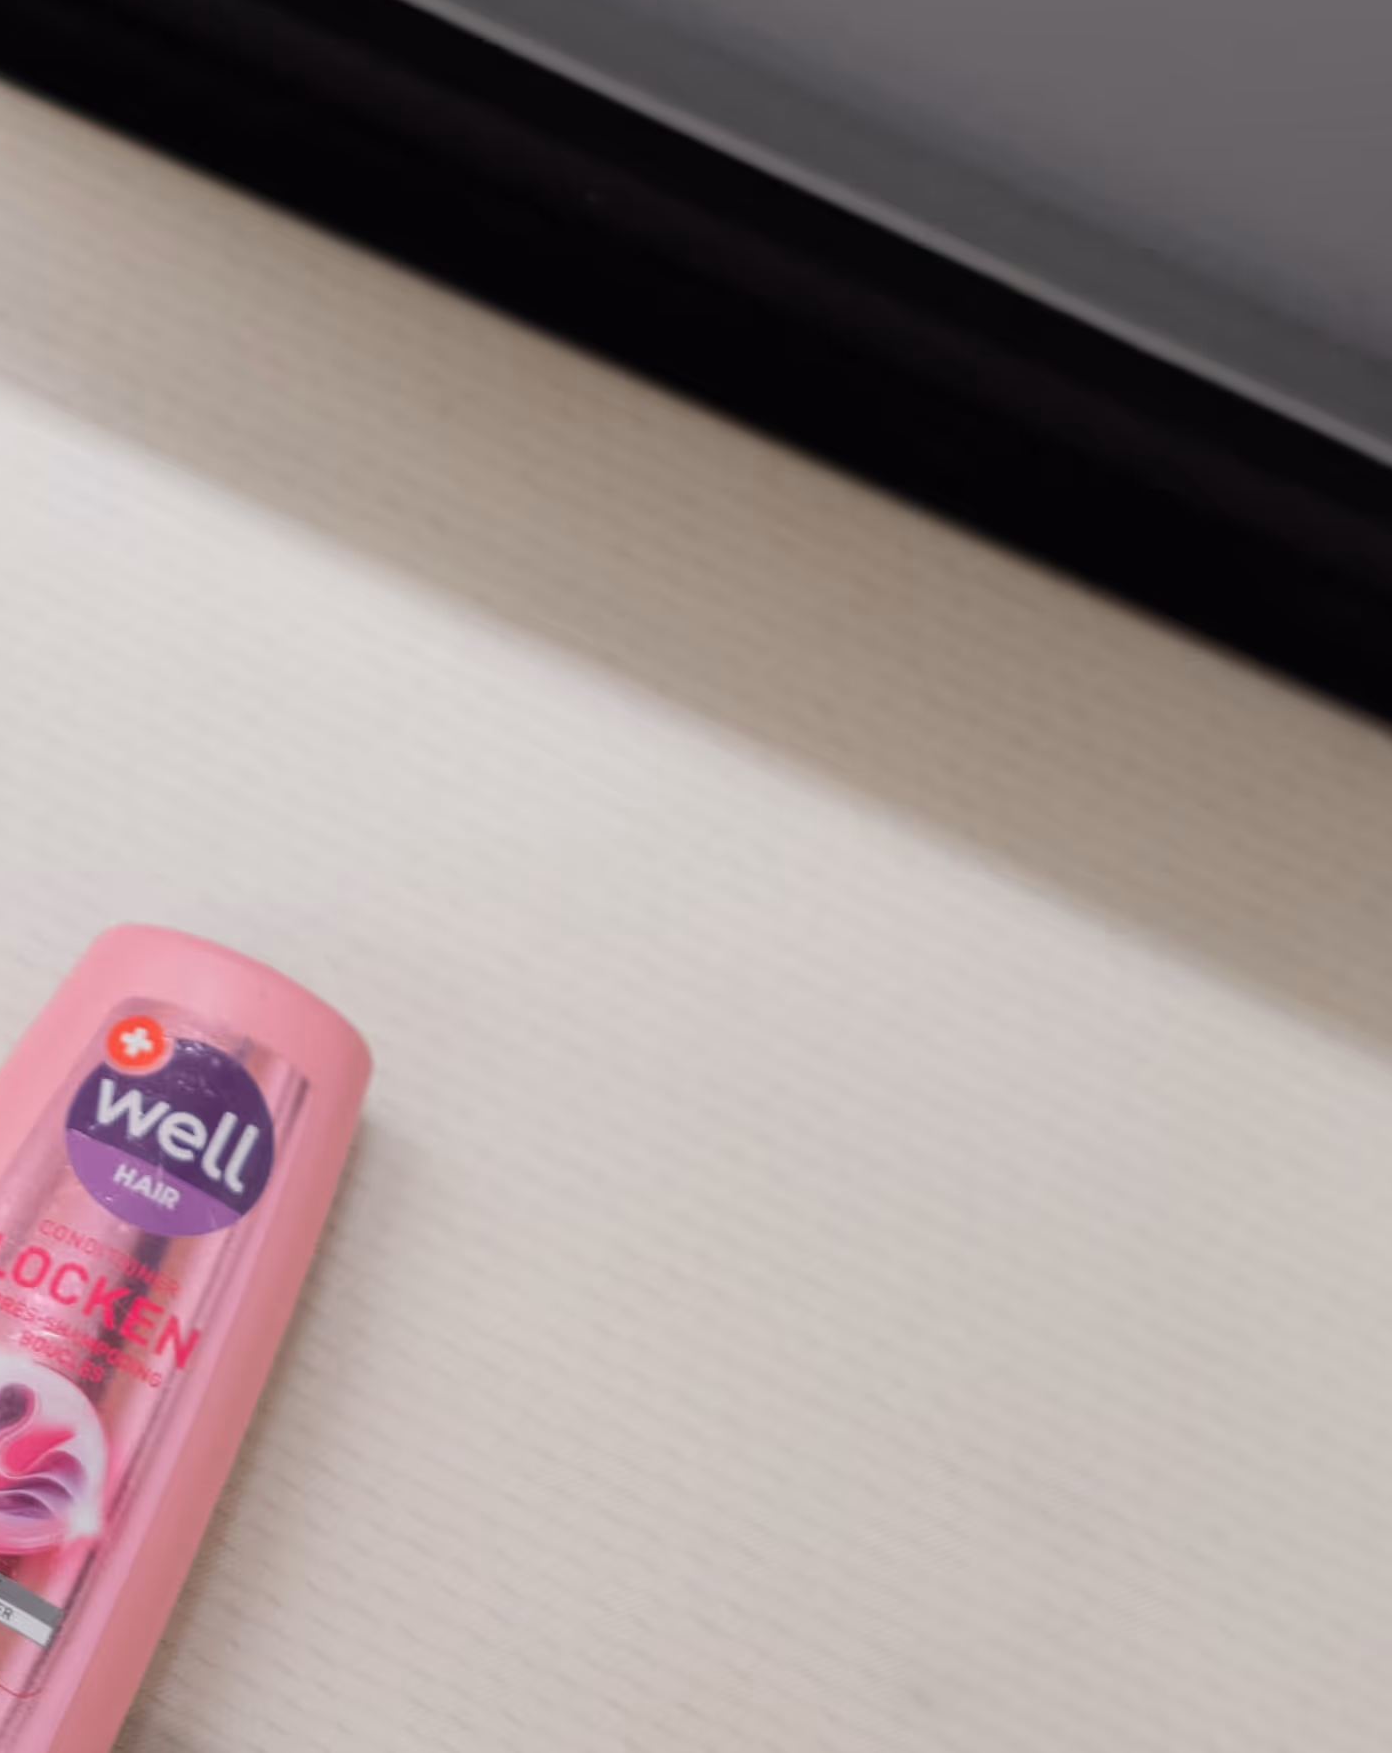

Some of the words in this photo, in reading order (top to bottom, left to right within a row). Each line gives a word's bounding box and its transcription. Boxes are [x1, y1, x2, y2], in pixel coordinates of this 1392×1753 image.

[95, 1077, 260, 1195] well
[112, 1161, 183, 1211] HAIR
[37, 1218, 180, 1296] CONDITIONER
[18, 1329, 105, 1384] BOUCLES
